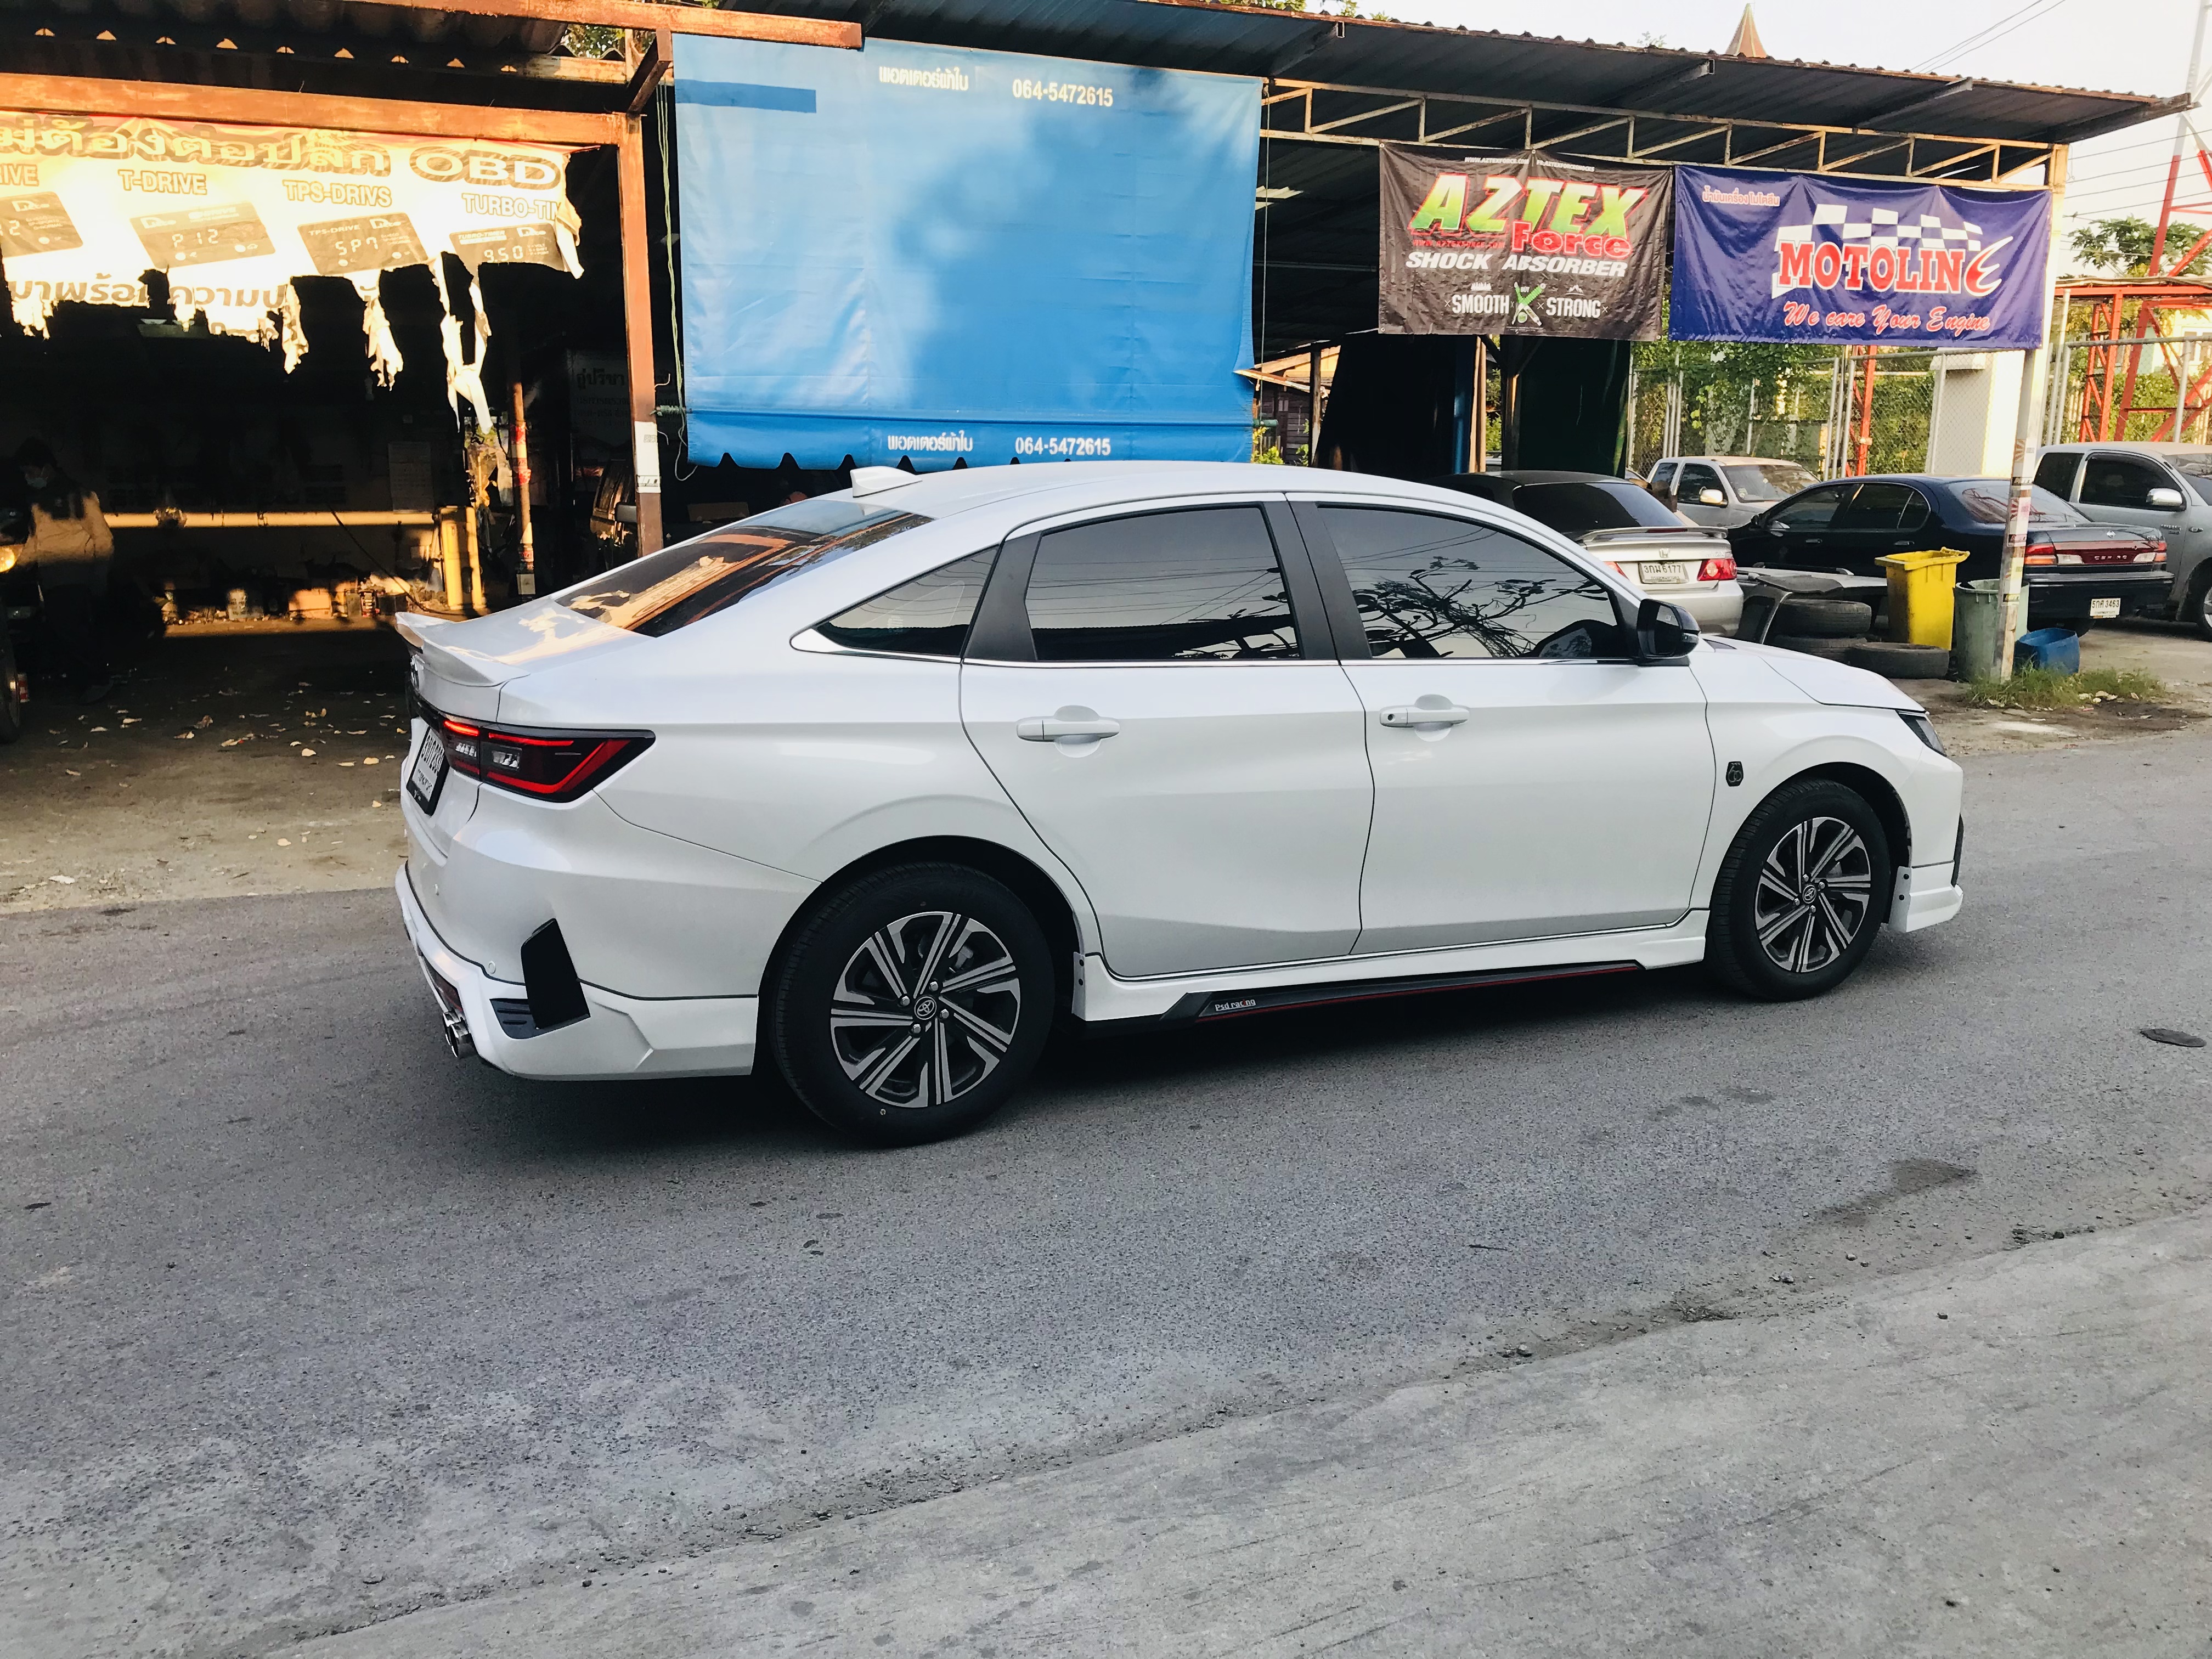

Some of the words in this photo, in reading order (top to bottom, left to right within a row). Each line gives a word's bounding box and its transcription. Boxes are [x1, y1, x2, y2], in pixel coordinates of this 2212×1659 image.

[1012, 78, 1114, 108] 064-5472615
[409, 146, 561, 190] OBD
[118, 169, 207, 195] T-DRIVE
[283, 179, 392, 208] TPS-DRIVS
[1408, 172, 1649, 240] AZTEX
[308, 224, 361, 236] TPS-DRIVE
[1511, 220, 1633, 260] Force
[1406, 251, 1494, 270] SHOCK
[1502, 254, 1628, 278] ABSORBER
[1452, 294, 1510, 315] SMOOTH
[1545, 296, 1601, 319] STRONG
[1782, 301, 1820, 328] We
[1825, 311, 1866, 328] care
[1871, 303, 1921, 336] Your
[1926, 306, 1990, 337] Engine
[1014, 436, 1111, 456] 064-5472615
[1662, 565, 1681, 573] 6177
[2105, 599, 2119, 608] 3463
[1215, 1002, 1229, 1011] Psd
[1230, 998, 1256, 1008] racing
